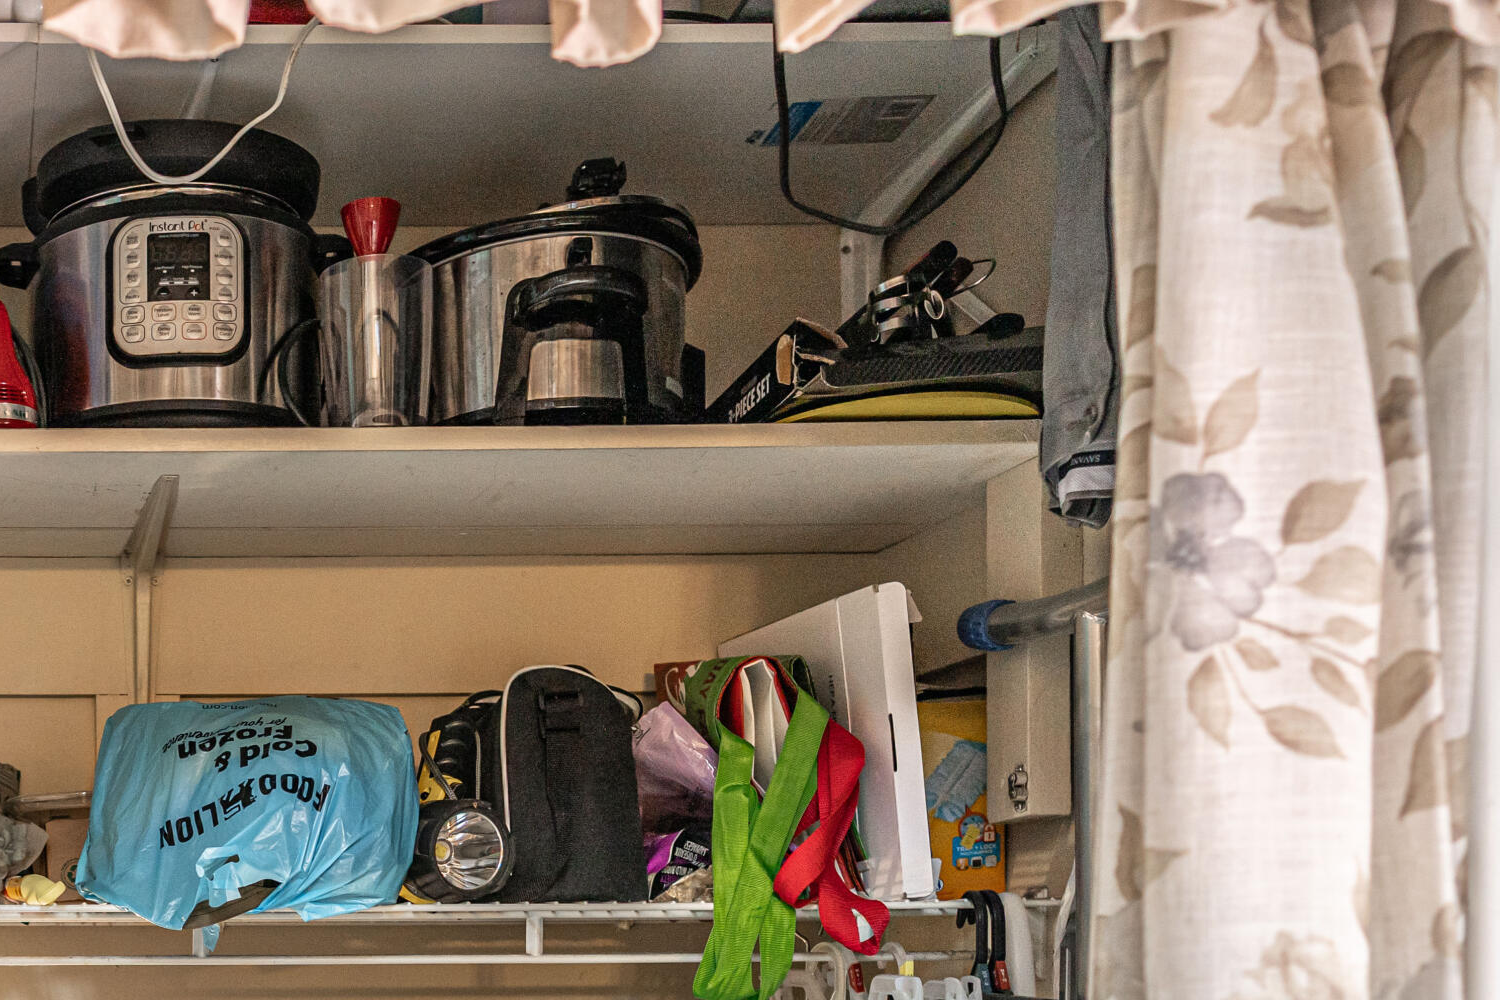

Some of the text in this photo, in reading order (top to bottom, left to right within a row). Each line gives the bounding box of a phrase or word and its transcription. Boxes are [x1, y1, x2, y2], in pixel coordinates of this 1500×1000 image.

[149, 220, 184, 232] Instant
[188, 220, 206, 232] Pot
[177, 725, 293, 760] Frozen
[214, 740, 317, 773] Cold &
[159, 773, 331, 850] FOOD LION
